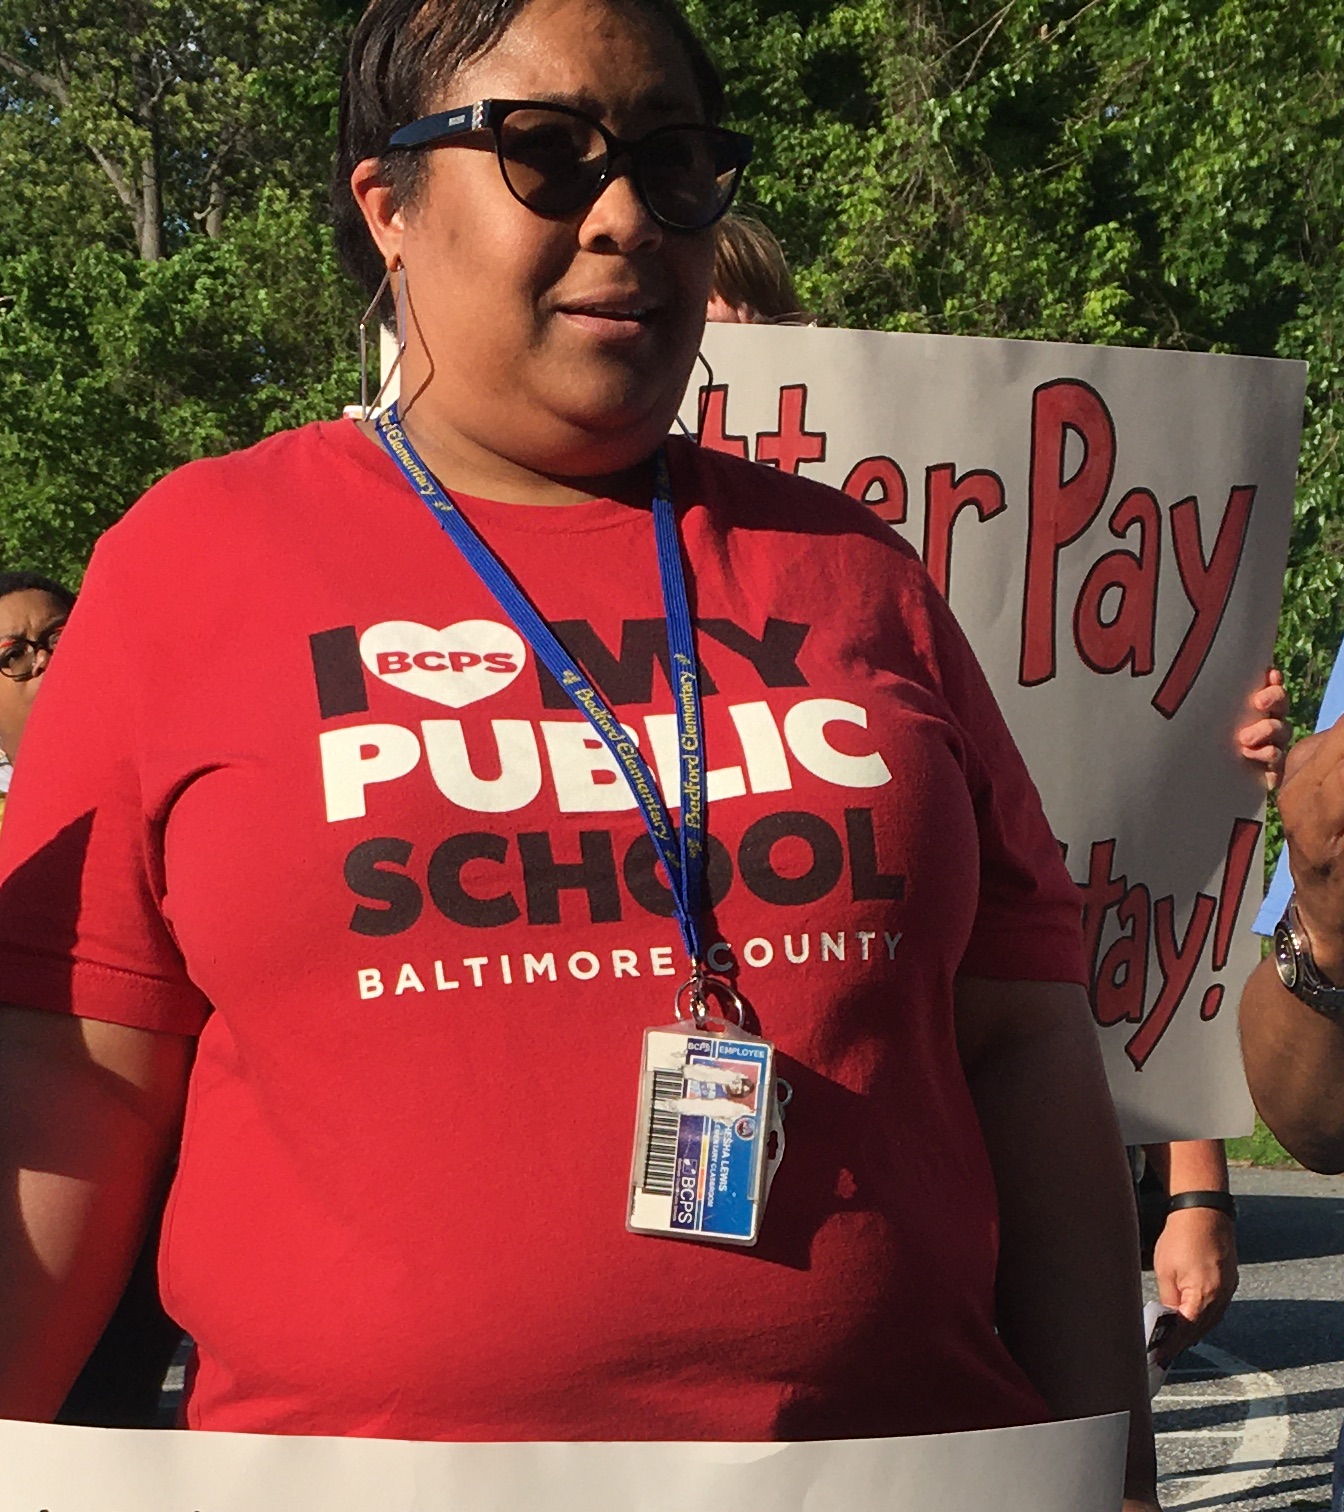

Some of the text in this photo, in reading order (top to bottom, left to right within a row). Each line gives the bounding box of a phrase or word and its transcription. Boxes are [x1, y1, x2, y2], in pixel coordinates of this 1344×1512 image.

[1019, 377, 1256, 719] Pay
[309, 617, 812, 719] I BCPS MY
[318, 698, 894, 823] PUBLIC
[574, 687, 670, 841] Bedford Elementary
[679, 671, 702, 830] Bedford Elementary
[342, 807, 907, 937] SCHOOL
[357, 931, 904, 1000] BALTIMORE COUNTY
[1068, 817, 1263, 1072] tay!
[677, 1176, 696, 1224] BCPS
[718, 1160, 731, 1192] LEWIS
